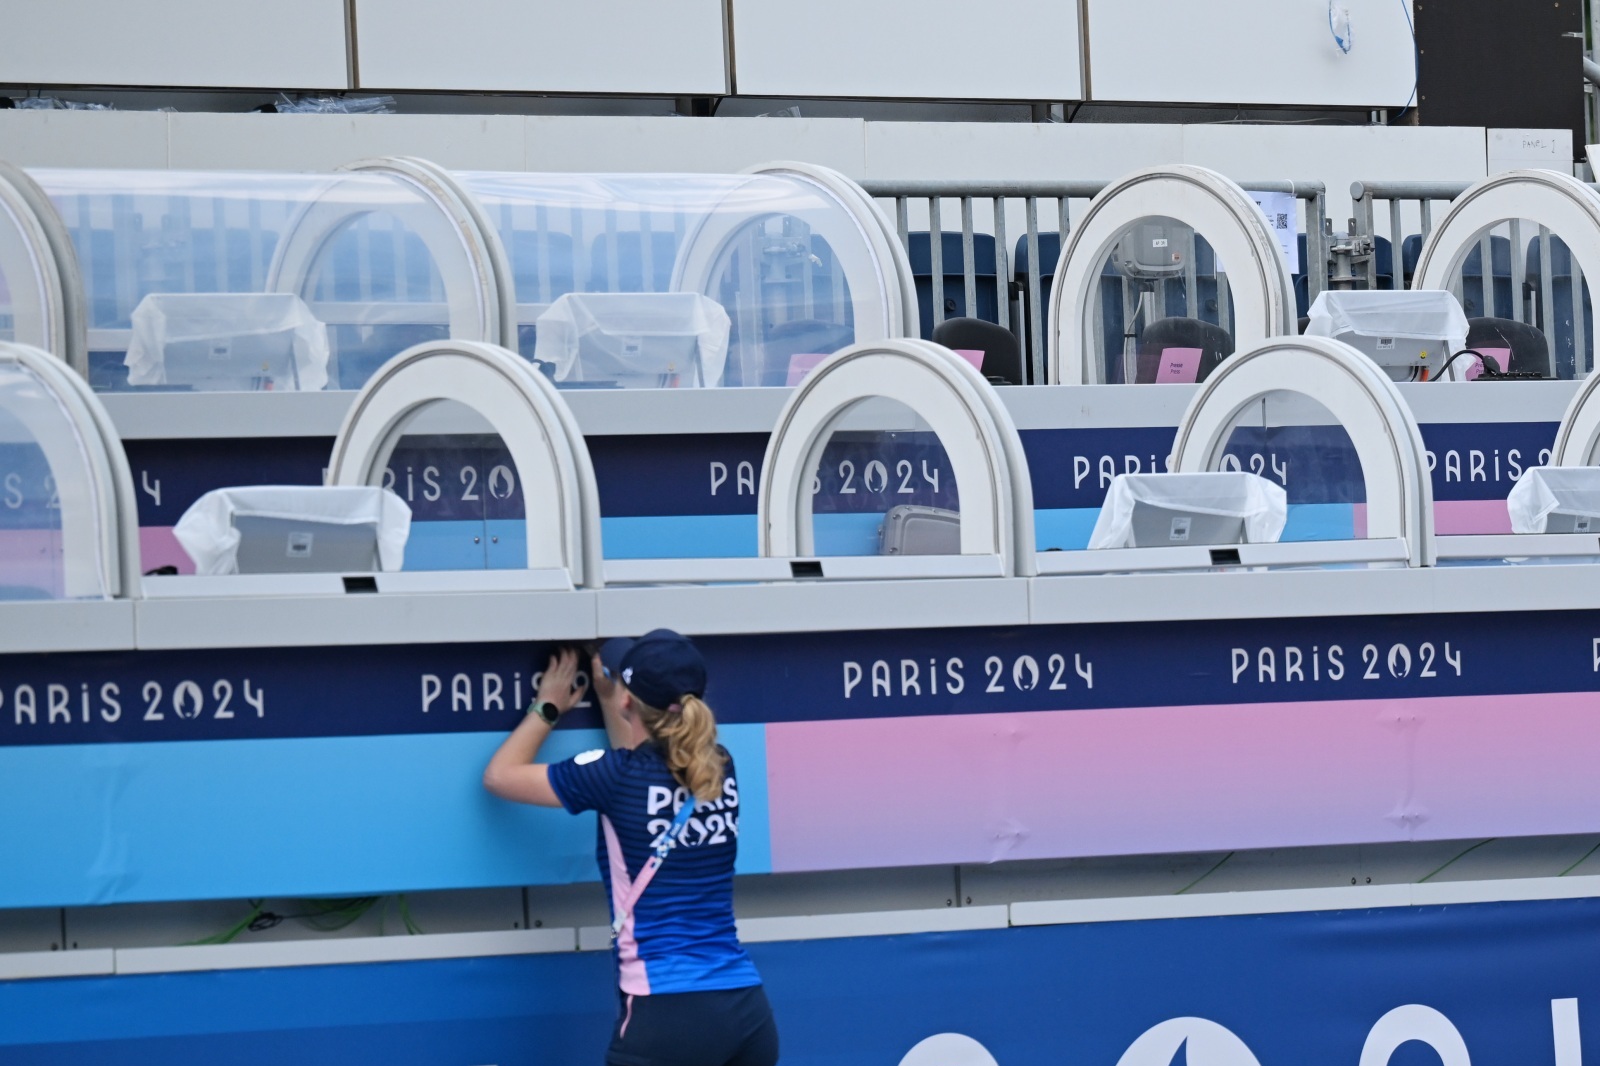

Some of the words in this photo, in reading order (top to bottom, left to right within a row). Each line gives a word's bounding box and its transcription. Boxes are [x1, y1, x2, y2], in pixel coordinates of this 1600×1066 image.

[839, 460, 939, 494] 2024
[984, 653, 1094, 693] 2024
[1362, 641, 1462, 679] 2024
[142, 679, 265, 721] 2024
